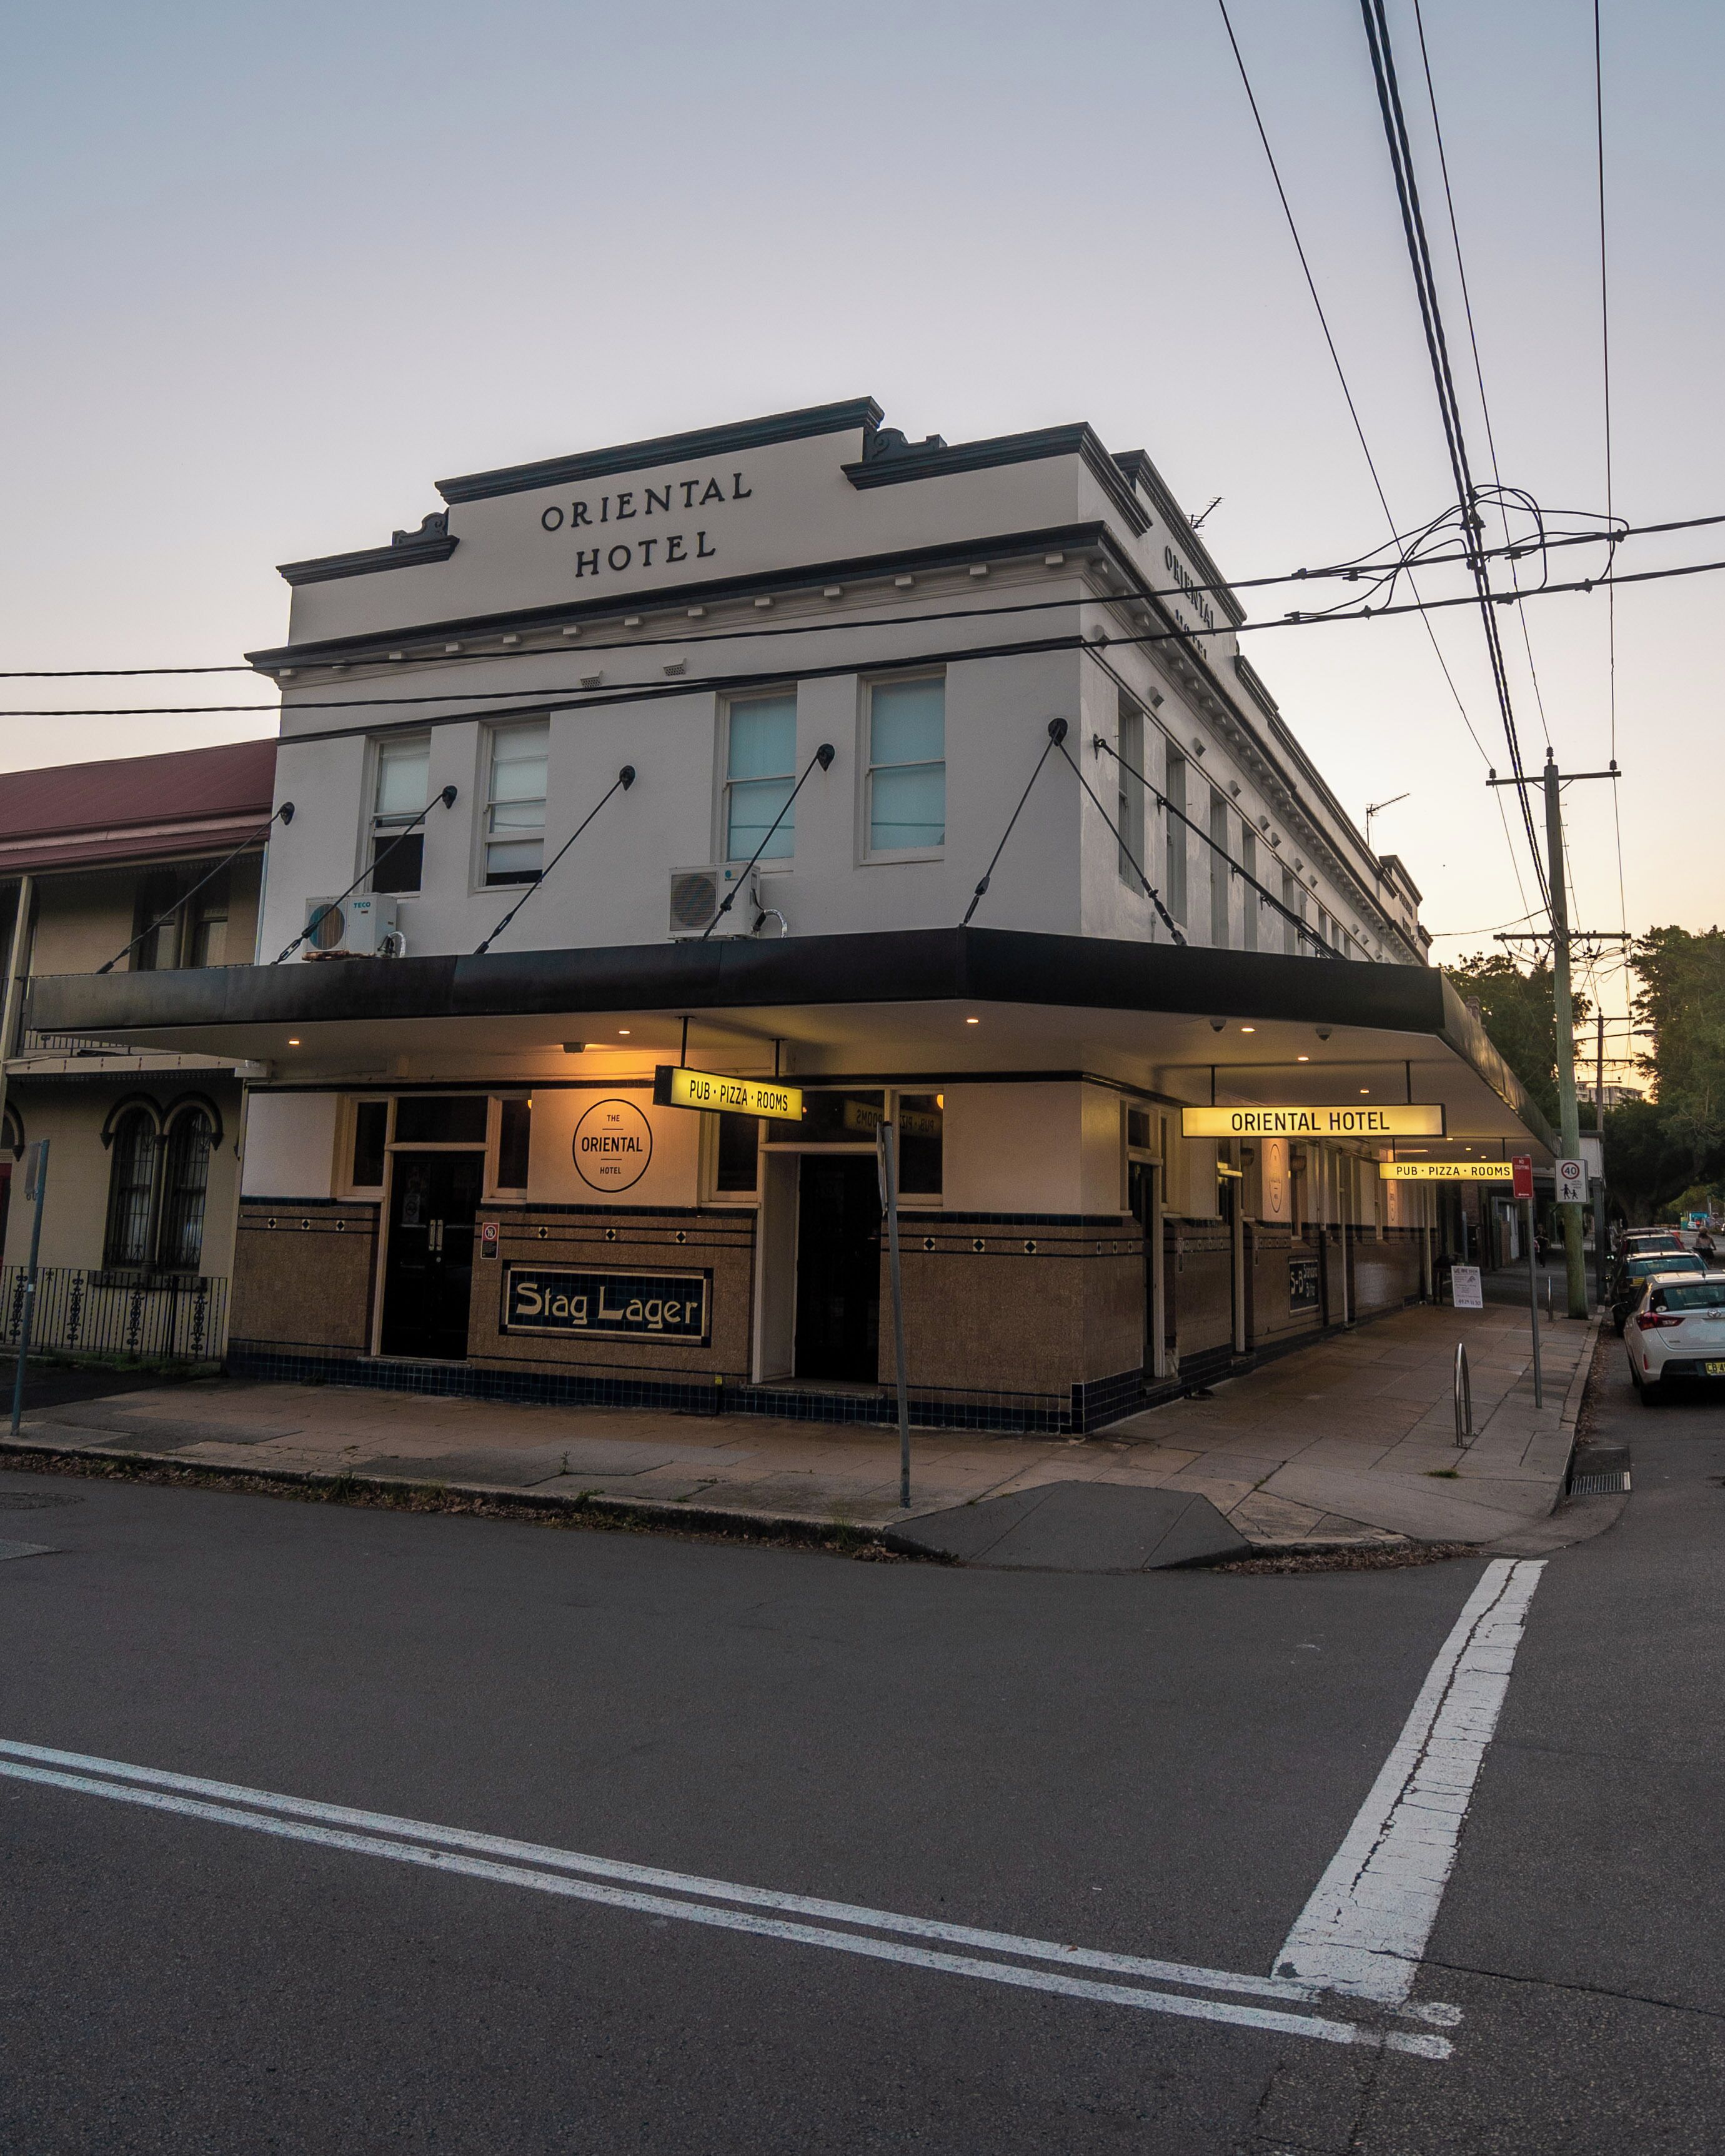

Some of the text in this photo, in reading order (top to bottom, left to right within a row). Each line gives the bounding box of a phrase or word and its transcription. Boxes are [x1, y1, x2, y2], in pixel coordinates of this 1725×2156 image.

[541, 472, 752, 532] ORIENTAL
[575, 531, 716, 578] HOTEL
[1165, 545, 1216, 636] ORIENTAL
[689, 1080, 788, 1112] PUB PIZZA ROOMS
[607, 1114, 620, 1122] THE
[1231, 1111, 1390, 1131] ORIENTAL HOTEL
[581, 1136, 644, 1152] ORIENTAL
[600, 1166, 622, 1175] HOTEL
[1396, 1166, 1510, 1176] PUB PIZZA ROOMS
[1564, 1166, 1577, 1175] 40
[515, 1282, 698, 1329] Stag Lager
